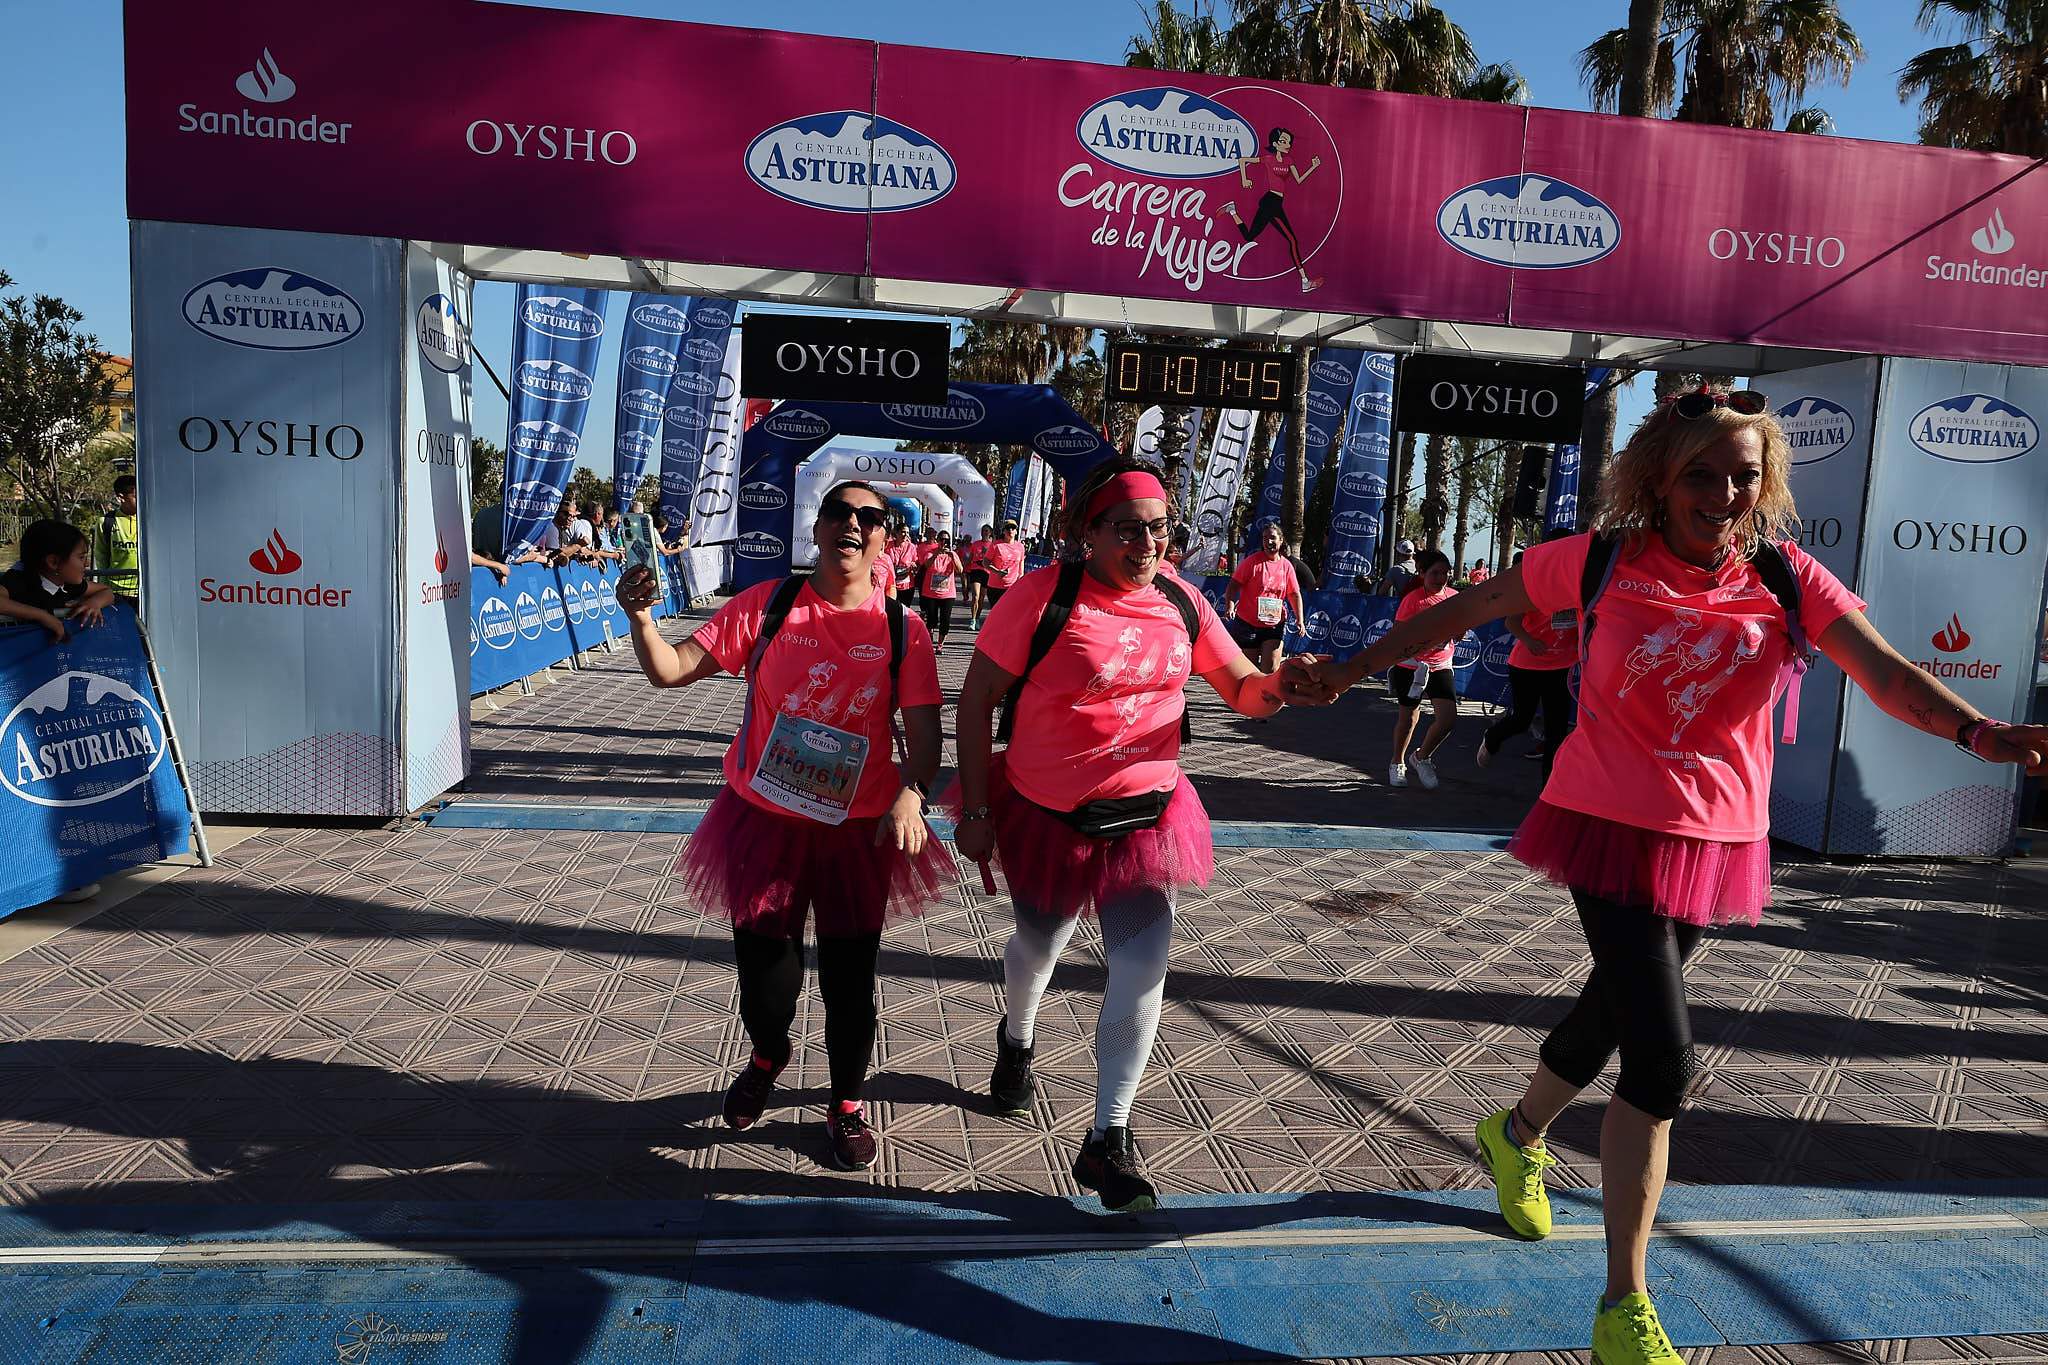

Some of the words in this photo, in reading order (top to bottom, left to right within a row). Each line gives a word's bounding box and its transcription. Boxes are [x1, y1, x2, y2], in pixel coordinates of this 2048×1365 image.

[178, 103, 352, 144] Santander
[1120, 114, 1177, 127] CENTRAL
[1183, 121, 1240, 133] LECHERA
[465, 119, 637, 165] OYSHO
[1090, 114, 1243, 159] ASTURIANA
[795, 142, 861, 155] CENTRAL
[868, 149, 935, 161] LECHERA
[760, 142, 940, 191] ASTURIANA
[1057, 163, 1207, 220] Carrera
[1481, 203, 1537, 216] CENTRAL
[1543, 208, 1602, 221] LECHERA
[1450, 202, 1605, 248] ASTURIANA
[1091, 214, 1120, 245] de
[1125, 217, 1144, 248] la
[1138, 218, 1258, 291] Mujer
[1707, 228, 1846, 268] OYSHO
[1925, 255, 2048, 288] Santander
[196, 293, 351, 333] ASTURIANA
[224, 294, 282, 305] CENTRAL
[287, 298, 345, 309] LECHERA
[524, 303, 597, 334] ASTURIANA
[630, 352, 675, 373] ASTURIAN
[775, 341, 921, 379] OYSHO
[1369, 358, 1395, 374] ASTUR
[520, 369, 588, 397] ASTURIANA
[1119, 352, 1281, 400] 01:01:45
[624, 396, 664, 415] ASTURIAN
[1358, 398, 1393, 416] ASTURI
[1430, 381, 1559, 418] OYSHO
[889, 403, 978, 421] ASTURIANA
[1783, 420, 1808, 430] NTRAL
[1810, 416, 1845, 427] LECHERA
[1939, 416, 1981, 426] CENTRAL
[1983, 419, 2027, 430] LECHERA
[178, 416, 364, 461] OYSHO
[767, 420, 825, 434] ASTURIANA
[1785, 427, 1846, 448] URIANA
[1916, 416, 2029, 449] ASTURIANA
[417, 429, 466, 468] OYSHO
[512, 431, 577, 456] ASTURIANA
[1040, 436, 1095, 448] ASTURIANA
[1350, 437, 1390, 456] ASTURIAN
[854, 455, 936, 476] OYSHO
[508, 491, 560, 514] ASTURIAN
[740, 492, 784, 505] ASTURIANA
[1752, 509, 1842, 547] OHO
[1893, 519, 2028, 555] OYSHO
[737, 540, 781, 553] ASTURIANA
[199, 578, 352, 607] Santander
[421, 580, 462, 605] Santander
[780, 632, 818, 648] OYSHO
[1484, 647, 1509, 665] ASTUR
[1911, 658, 2002, 679] ntander
[35, 714, 93, 737] CENTRAL
[16, 724, 157, 786] ASTURIANA
[761, 784, 790, 802] OYSHO
